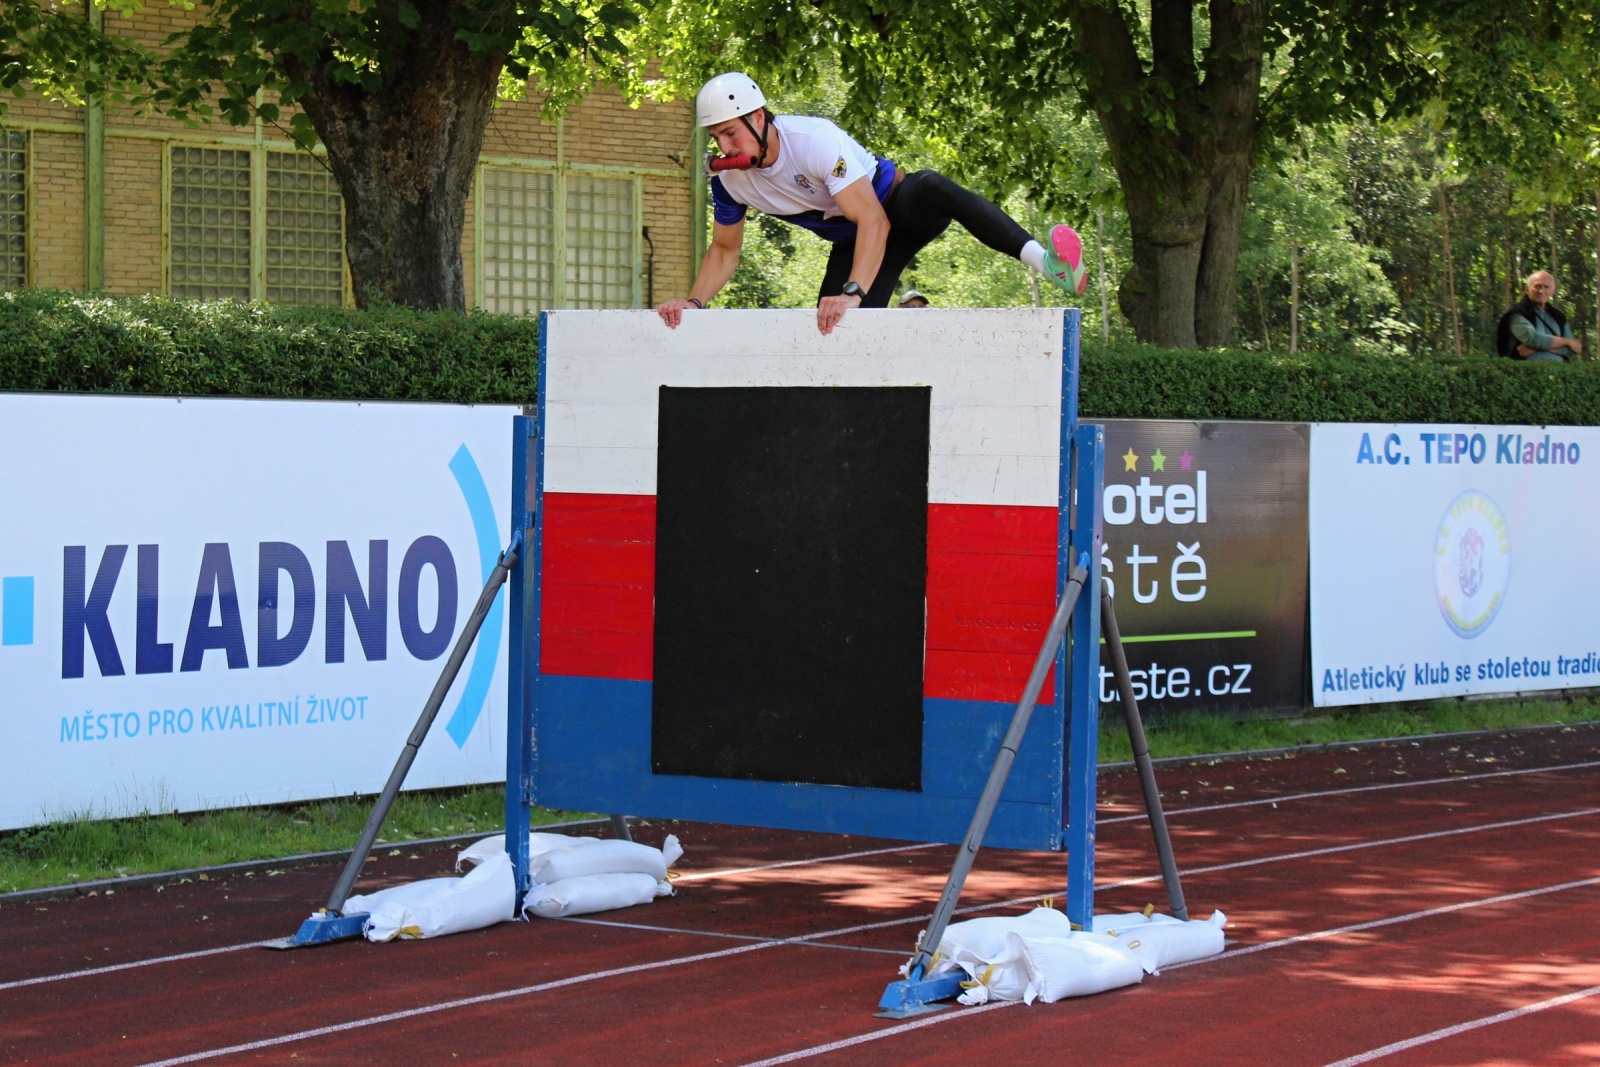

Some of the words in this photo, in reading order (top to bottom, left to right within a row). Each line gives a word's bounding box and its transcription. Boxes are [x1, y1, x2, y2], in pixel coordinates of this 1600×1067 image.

[1356, 432, 1411, 466] A.C.
[1420, 433, 1487, 465] TEPO
[1495, 433, 1581, 465] Kladno
[1102, 470, 1207, 525] otel
[61, 534, 459, 680] KLADNO
[1321, 663, 1406, 692] Atletický
[1414, 661, 1450, 686] klub
[1455, 664, 1471, 682] se
[1477, 656, 1551, 680] stoletou
[59, 709, 141, 743] MĚSTO
[148, 707, 194, 736] PRO
[201, 695, 300, 731] KVALITNÍ
[305, 694, 369, 724] ŽIVOT
